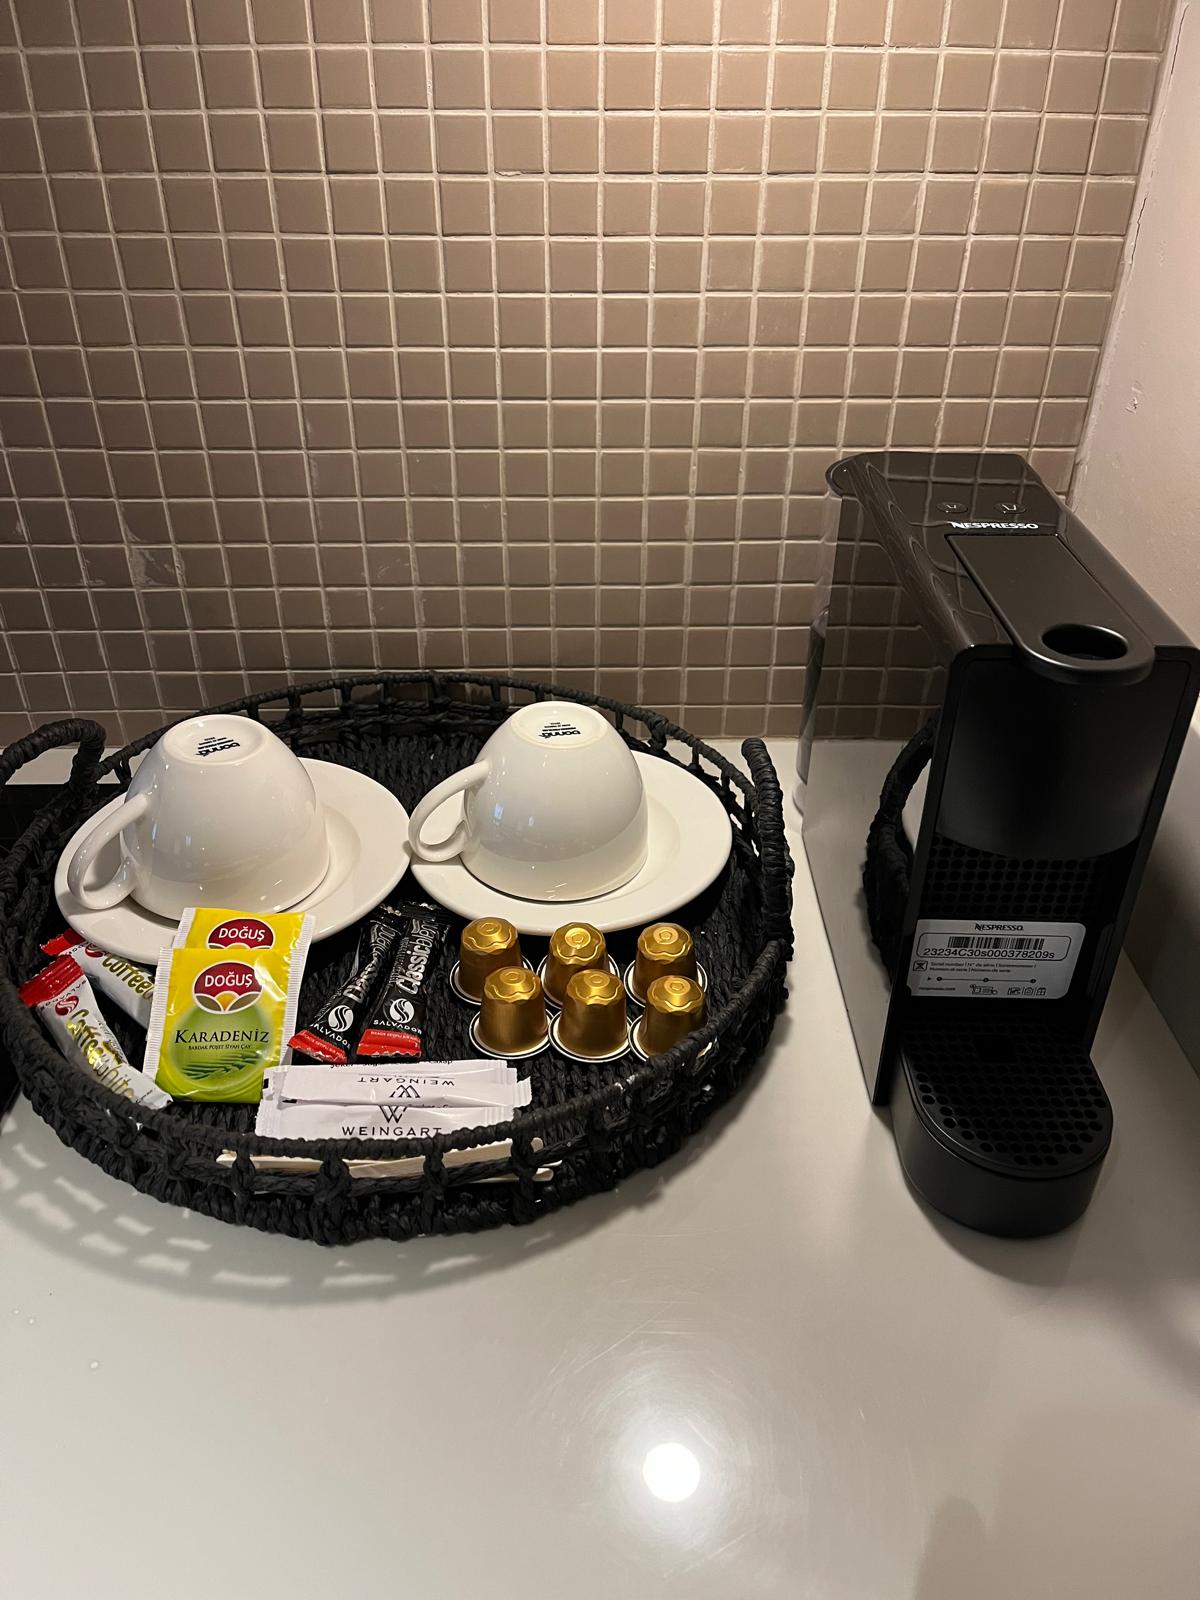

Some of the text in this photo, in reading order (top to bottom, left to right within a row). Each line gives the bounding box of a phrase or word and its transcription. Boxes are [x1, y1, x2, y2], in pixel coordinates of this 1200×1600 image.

[218, 925, 266, 942] DOĞUŞ
[975, 923, 1024, 931] NESPRESSO
[204, 971, 253, 988] DOĞUŞ
[373, 1019, 423, 1035] SALVADOR
[358, 1076, 455, 1087] WEINGART
[341, 1126, 443, 1137] WEINGART
